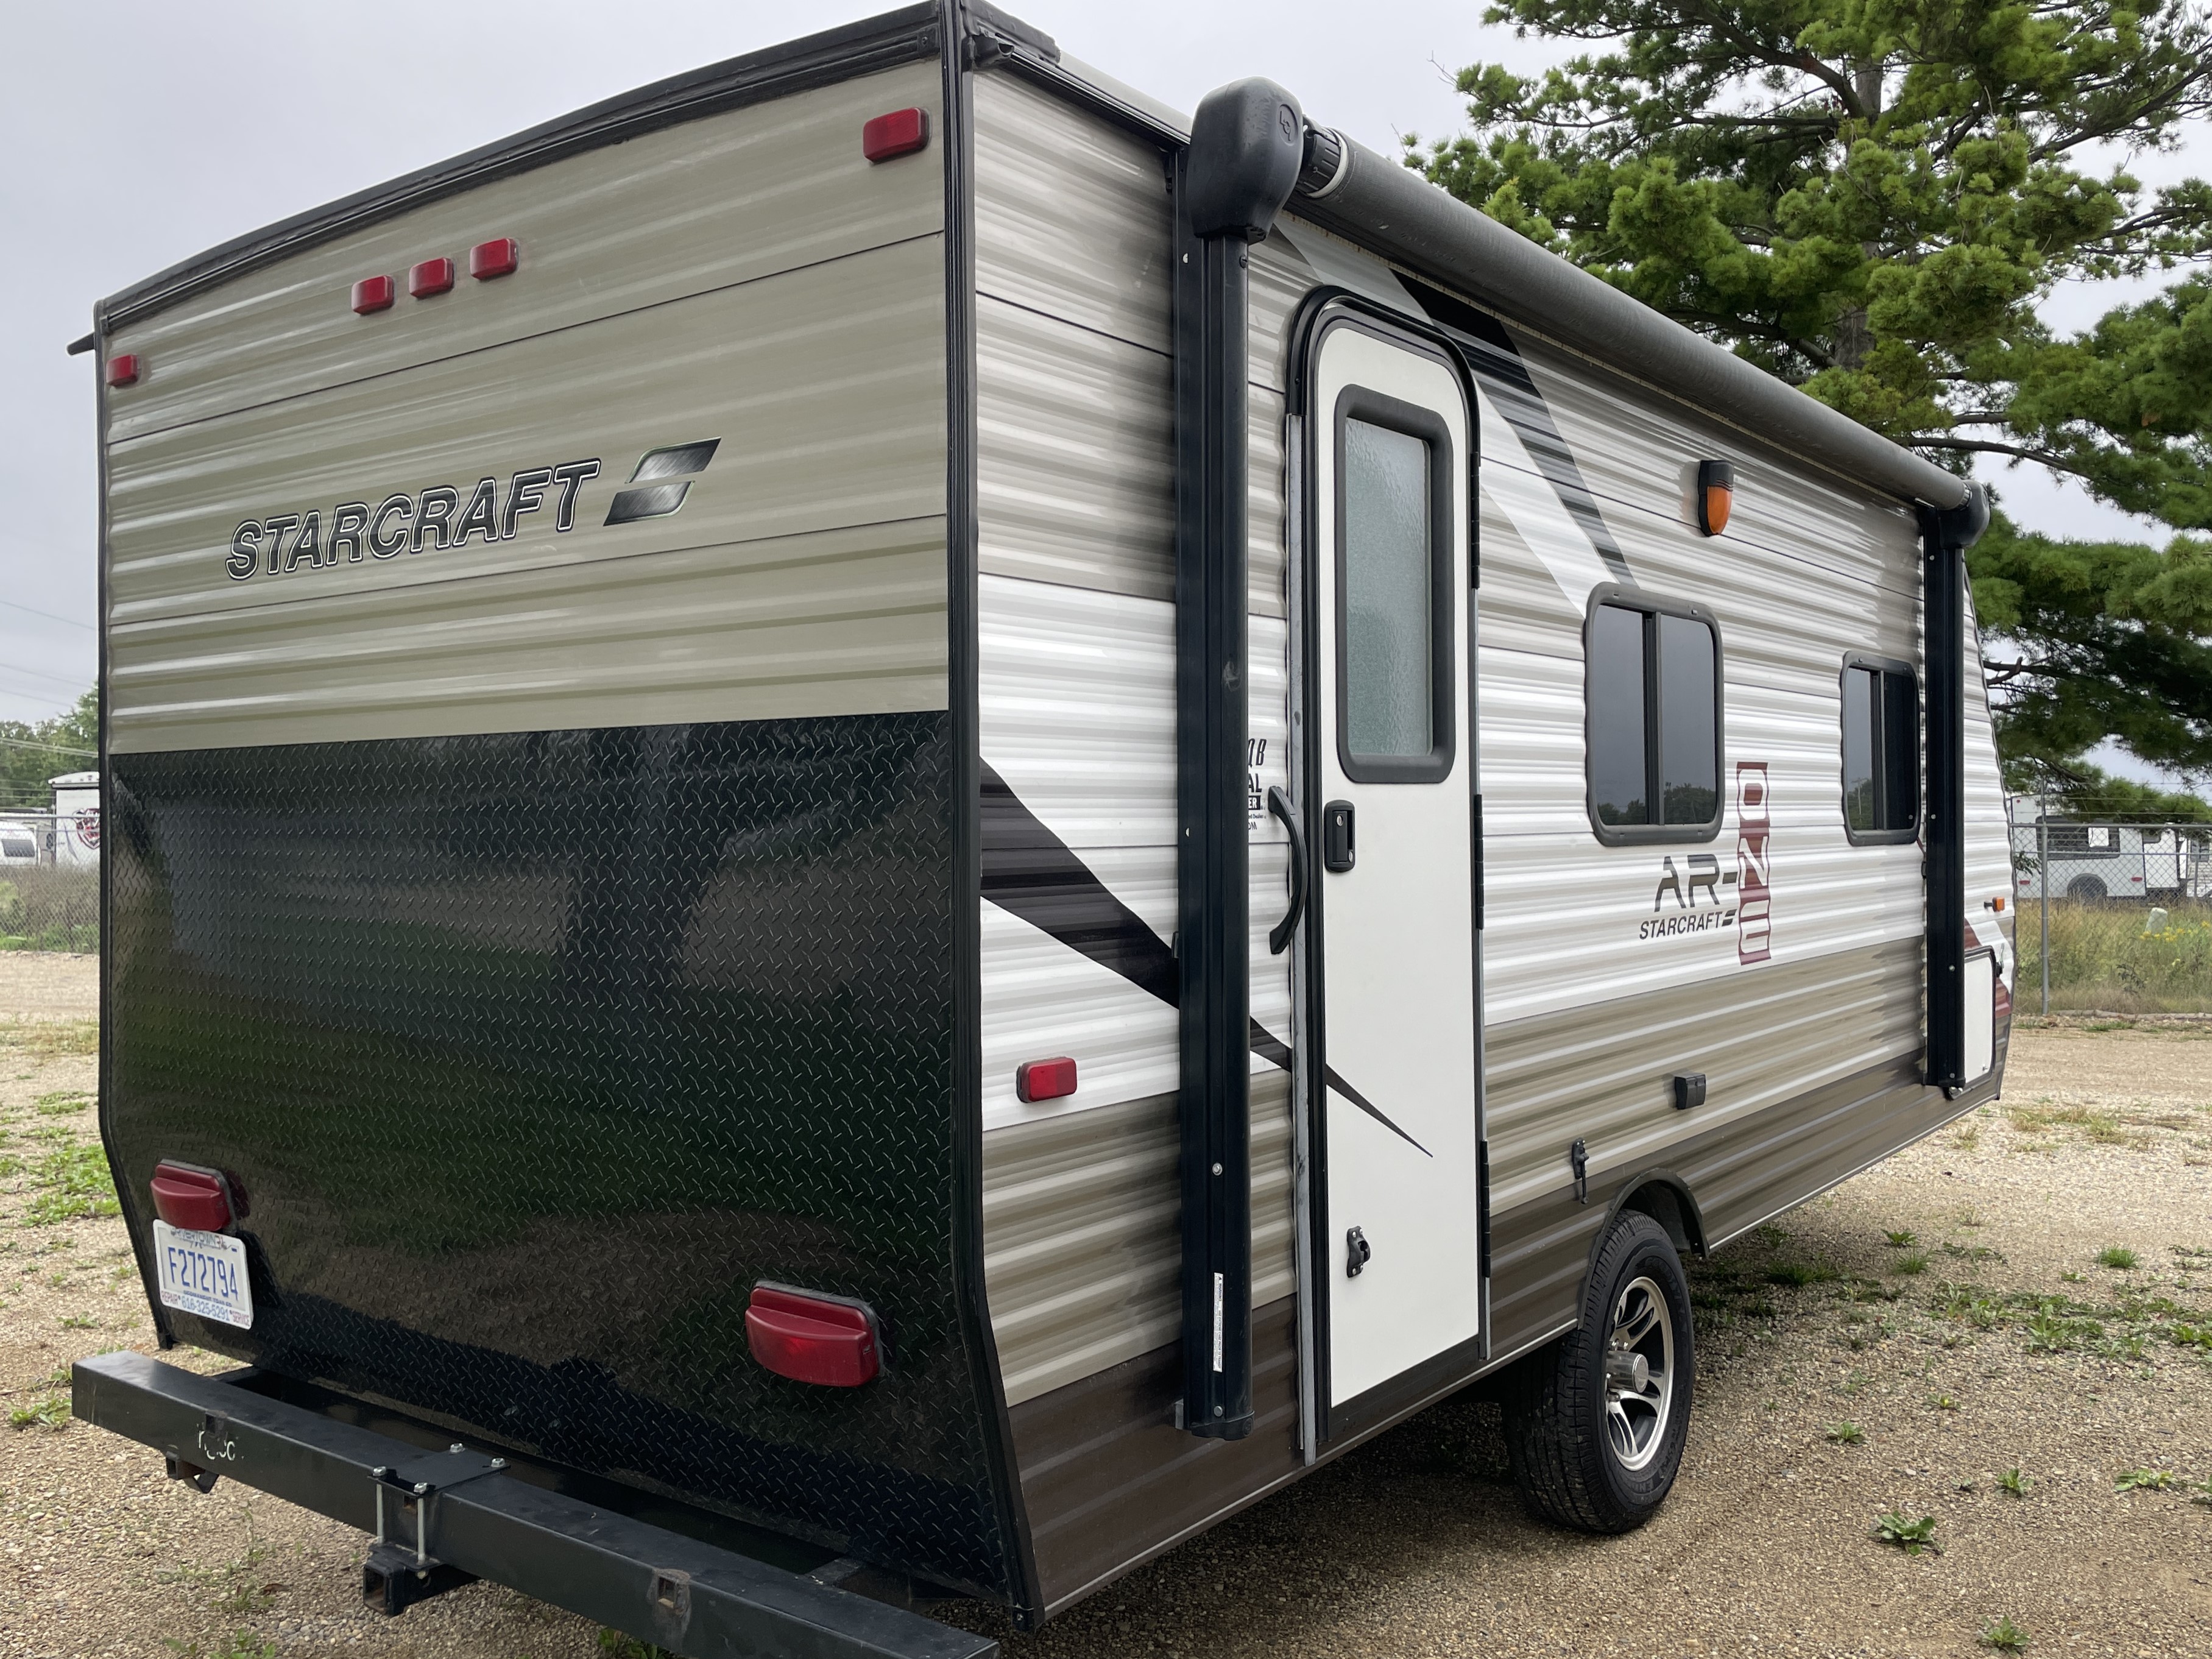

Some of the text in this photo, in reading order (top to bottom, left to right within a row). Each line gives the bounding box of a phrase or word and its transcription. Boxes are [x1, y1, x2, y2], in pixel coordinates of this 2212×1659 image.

[225, 458, 601, 581] STARCRAFT
[1639, 911, 1723, 939] STARCRAFT
[168, 1247, 238, 1301] F272794
[182, 1295, 230, 1321] 616-325-5291
